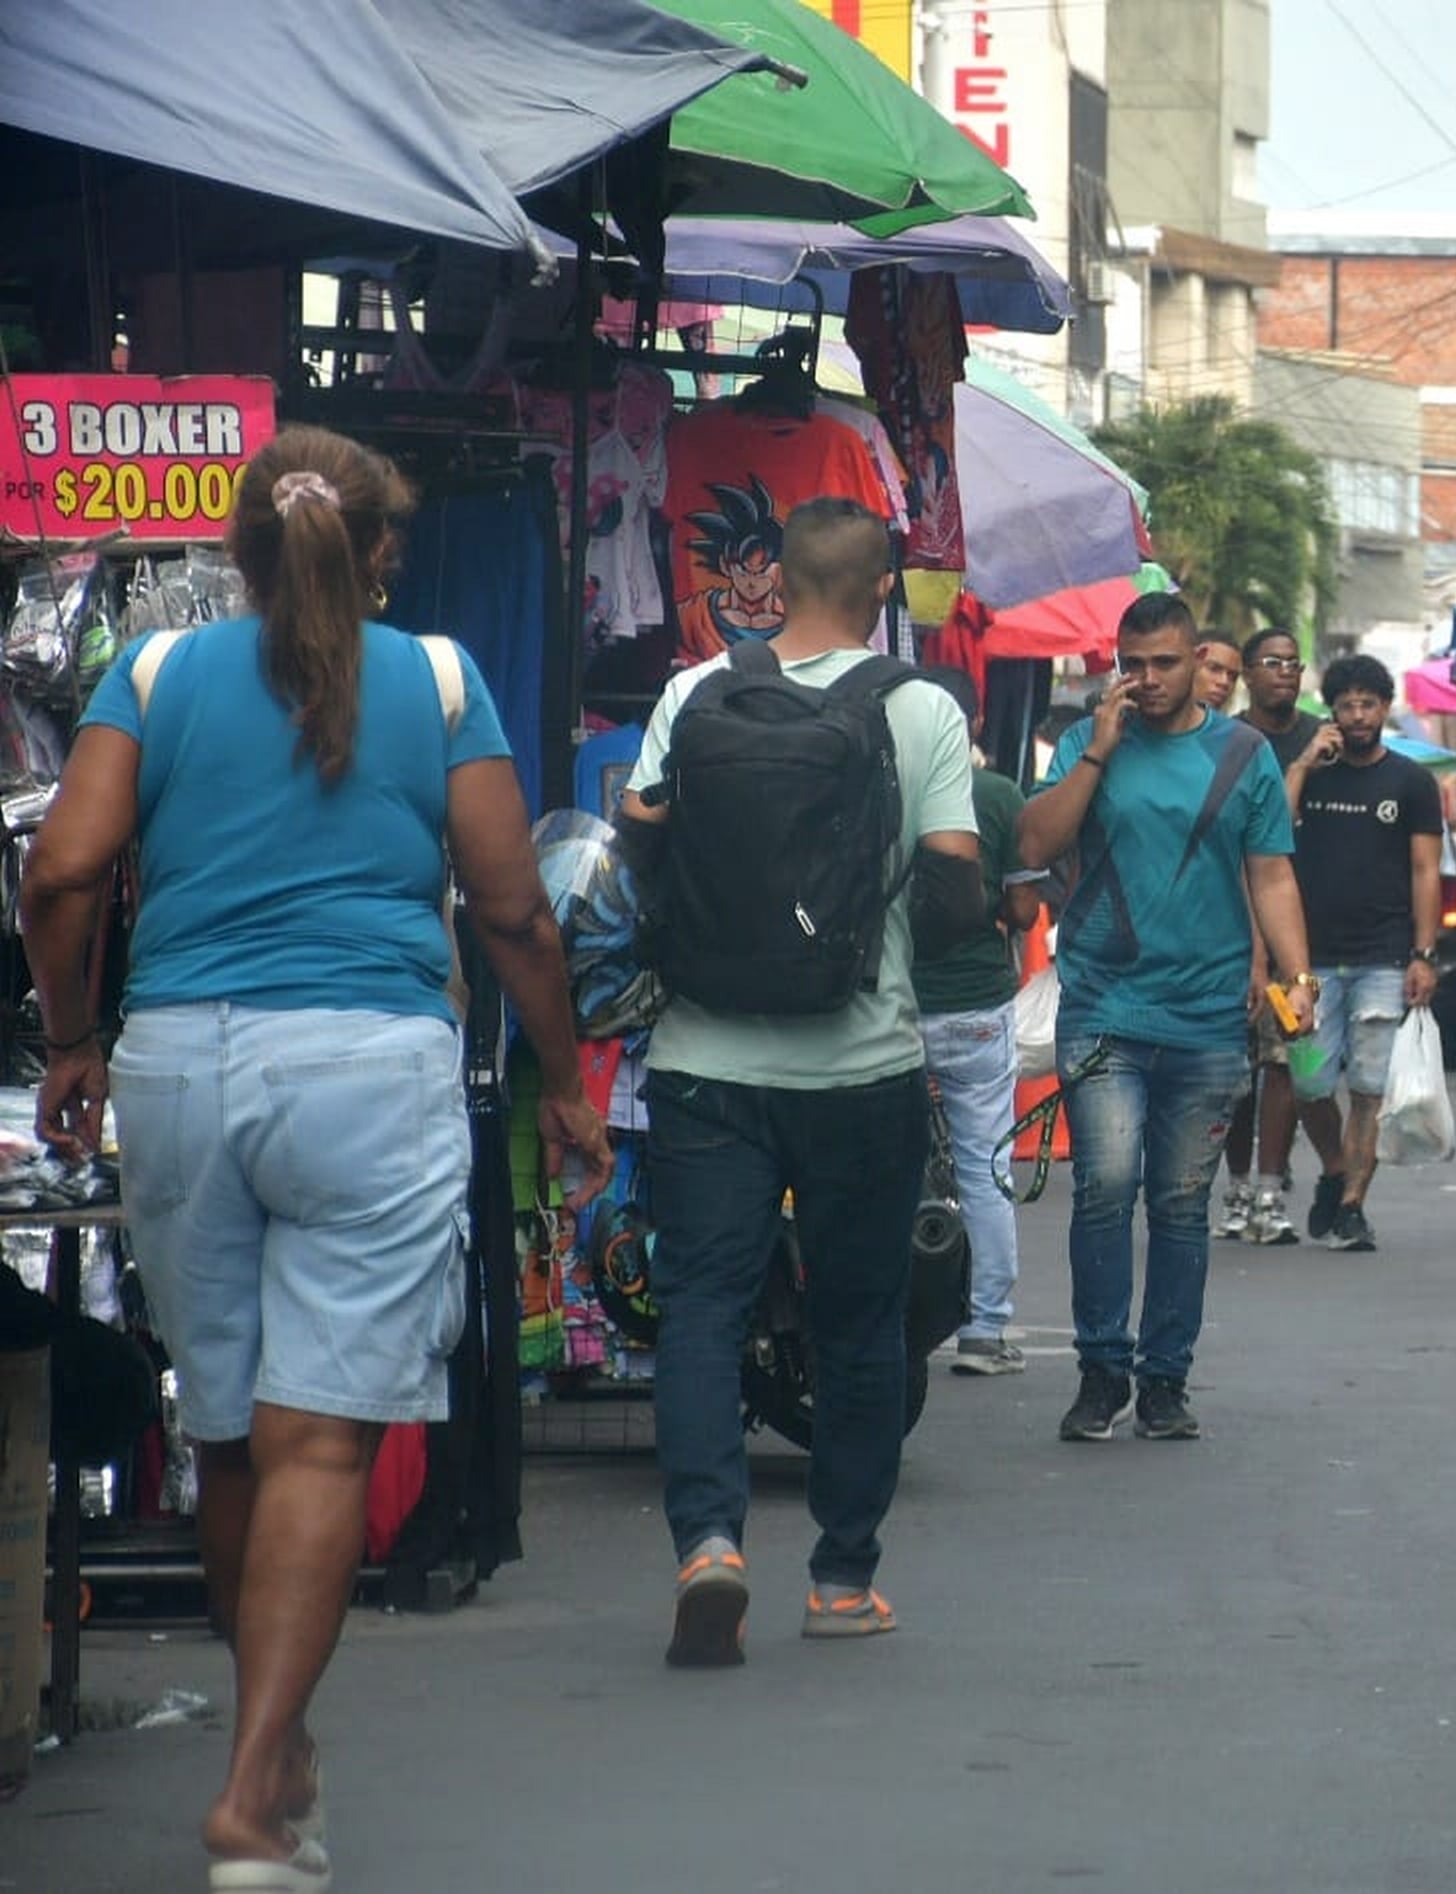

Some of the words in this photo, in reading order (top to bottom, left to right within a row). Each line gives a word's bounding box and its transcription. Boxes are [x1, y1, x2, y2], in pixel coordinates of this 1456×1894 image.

[23, 401, 58, 456] 3
[68, 401, 242, 456] BOXER
[5, 482, 45, 499] POR
